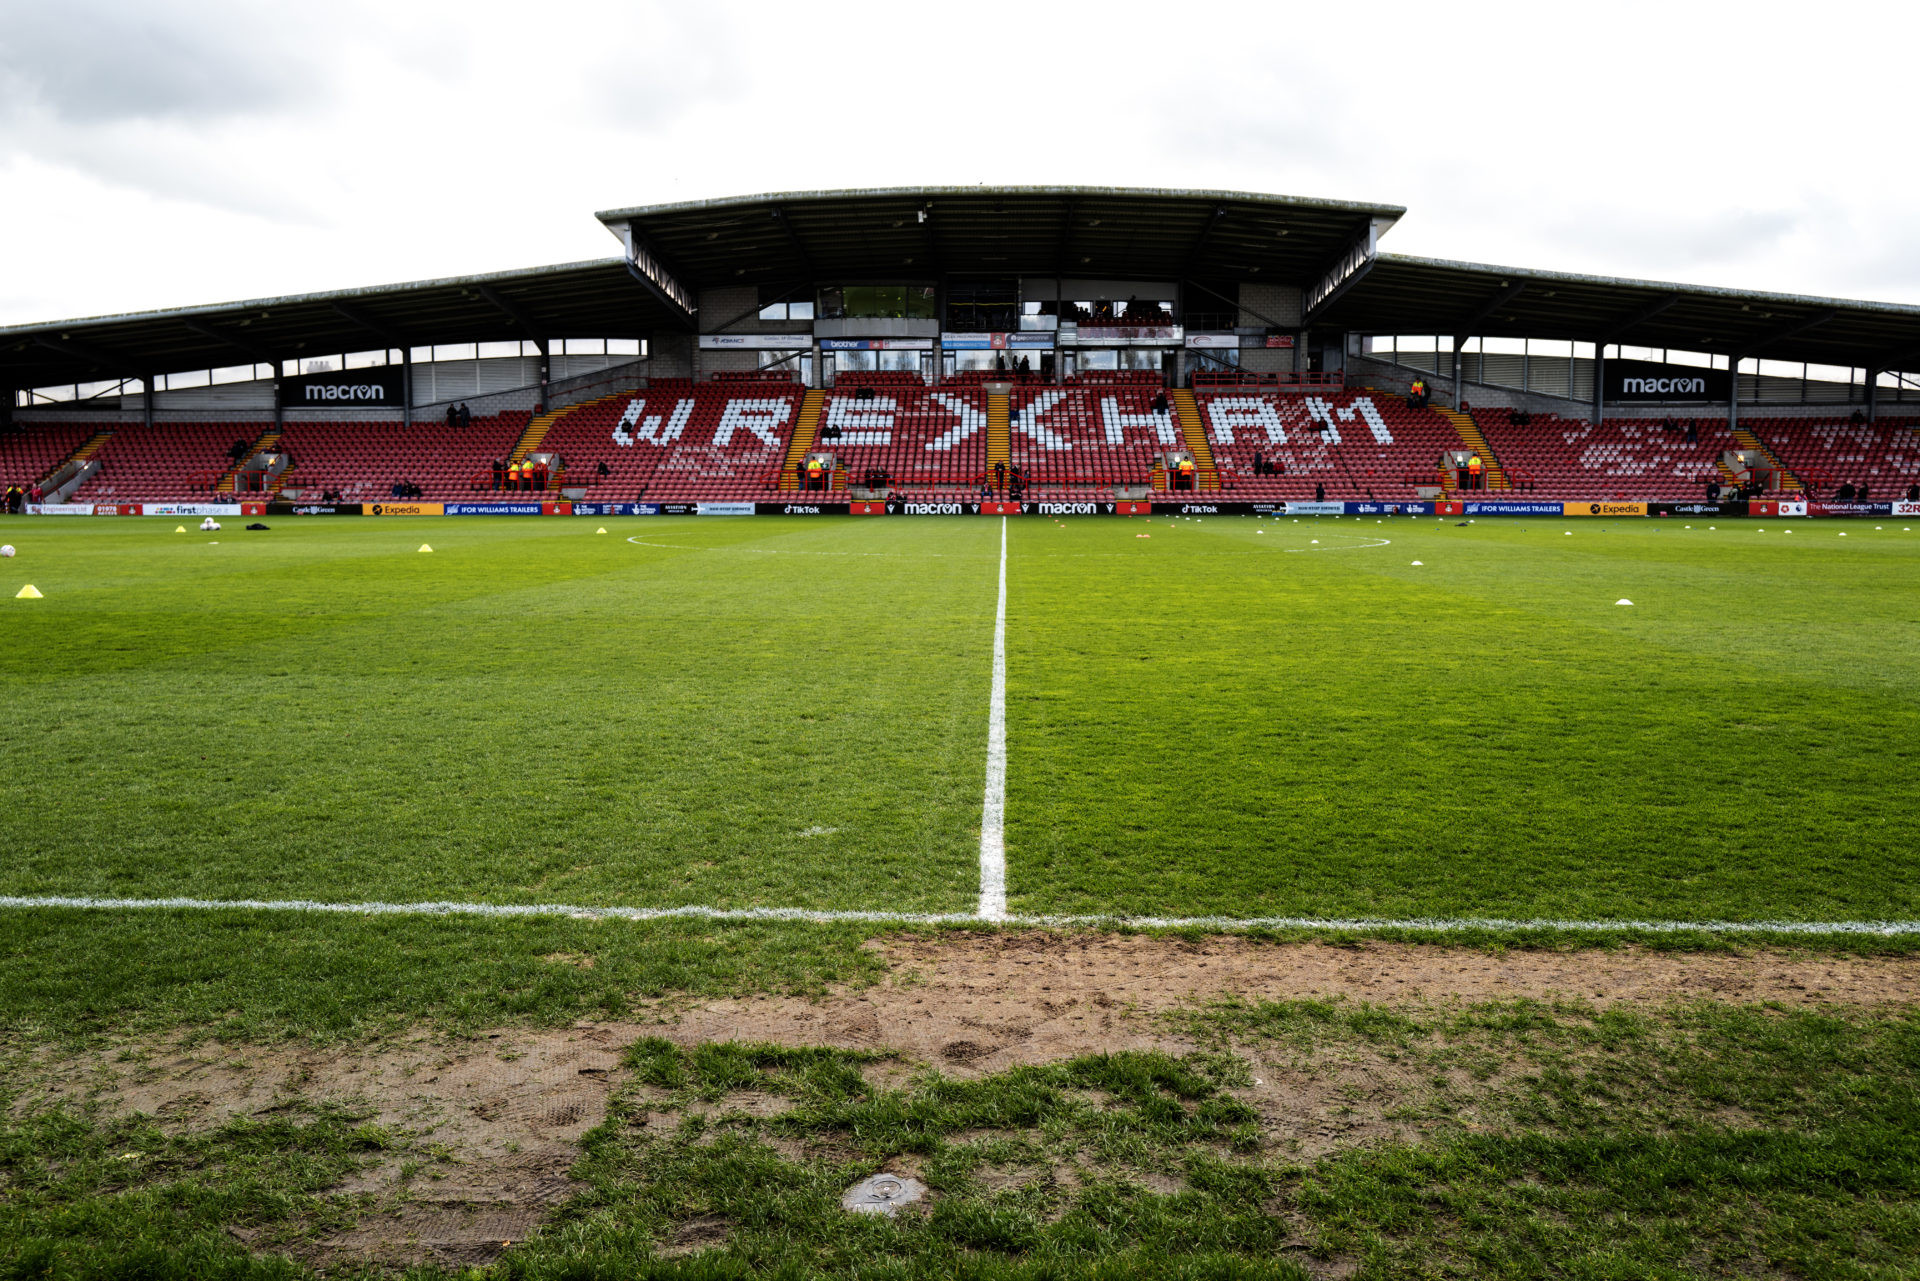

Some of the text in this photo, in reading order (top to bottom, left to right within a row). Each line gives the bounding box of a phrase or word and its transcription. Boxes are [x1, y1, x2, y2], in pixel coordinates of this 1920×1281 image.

[830, 340, 858, 348] brother
[1623, 378, 1705, 393] macron
[305, 385, 384, 400] macron
[611, 390, 1394, 450] WREXHAM
[384, 506, 420, 515] Expedia
[793, 506, 820, 514] TikTok
[904, 503, 962, 514] macron
[1039, 503, 1097, 514] macron
[1603, 505, 1639, 514] Expedia
[1850, 503, 1872, 511] League
